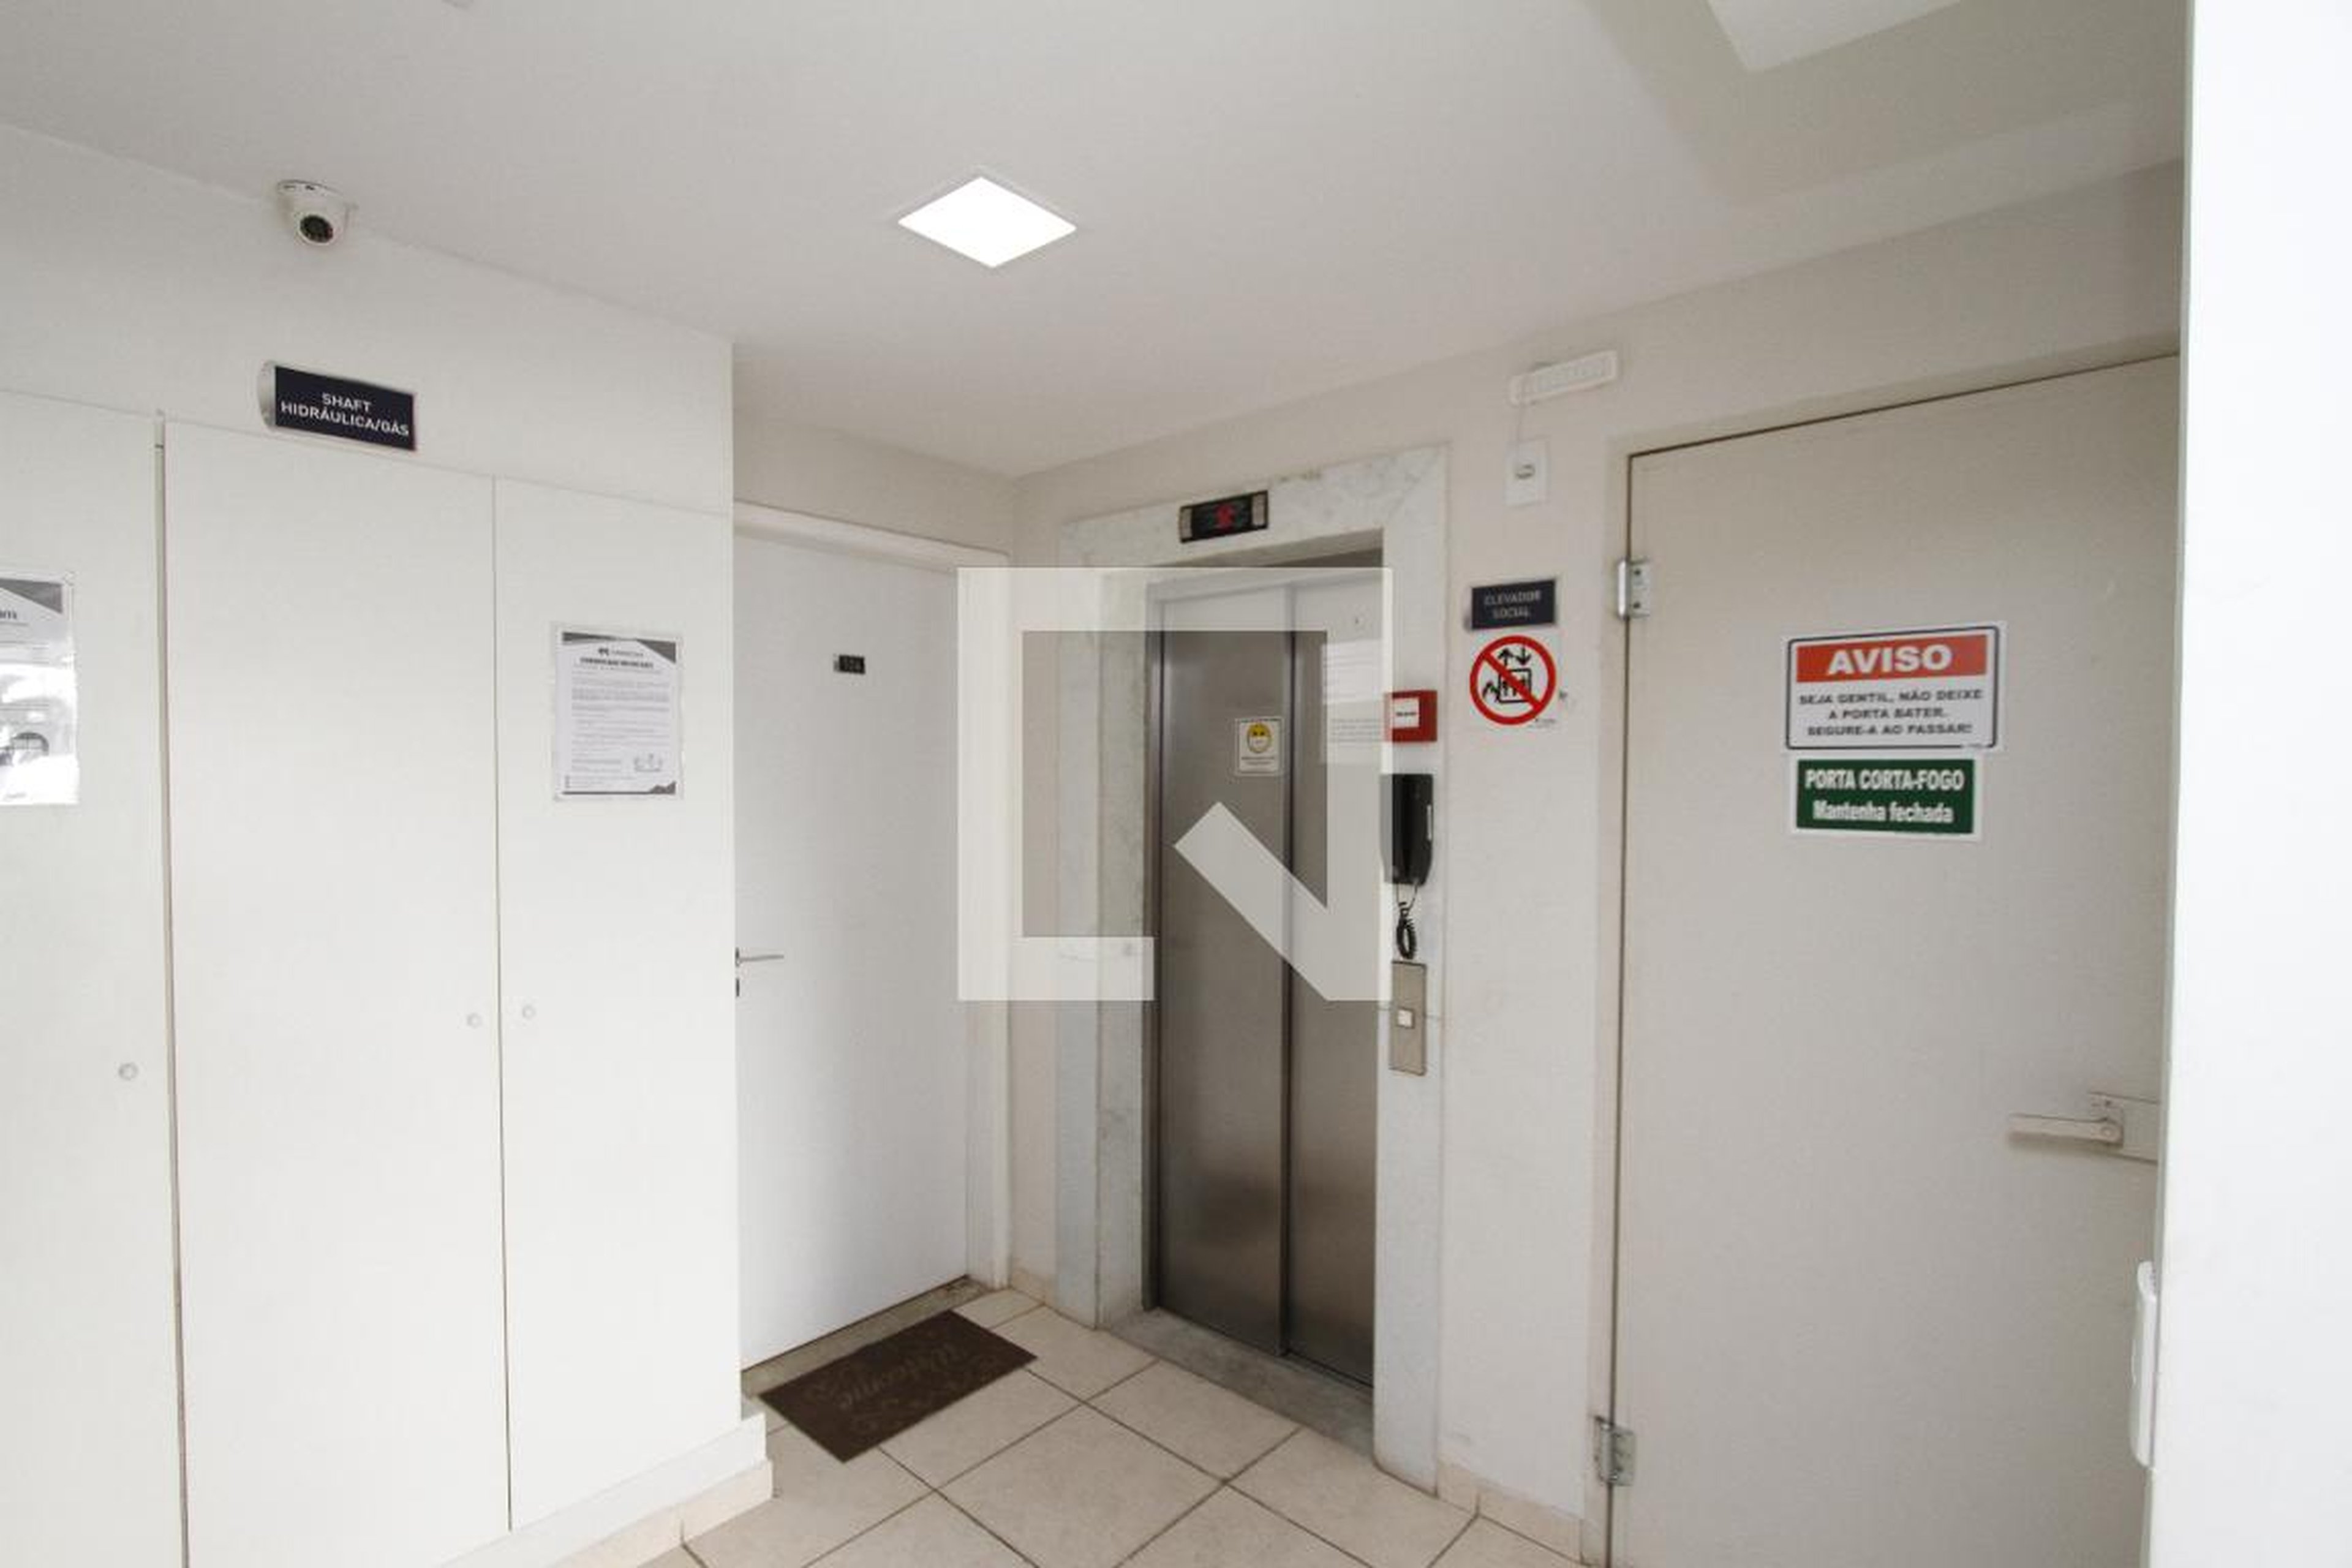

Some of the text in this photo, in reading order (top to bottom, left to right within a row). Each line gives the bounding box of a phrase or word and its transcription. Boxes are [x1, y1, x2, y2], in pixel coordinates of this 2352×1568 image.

[322, 392, 372, 412] SHAFT
[281, 401, 409, 435] HIDRÁULICA/GÁS
[1826, 644, 1953, 676] AVISO
[1799, 693, 1833, 705] SEJA
[1899, 690, 1931, 701] NÃO
[1936, 689, 1983, 701] DEIXE
[1828, 707, 1947, 720] A PORTA BATER.
[1881, 725, 1902, 734] AO
[1804, 769, 1965, 791] PORTA CORTA-FOGO
[1812, 799, 1954, 823] Mantenha fechada
